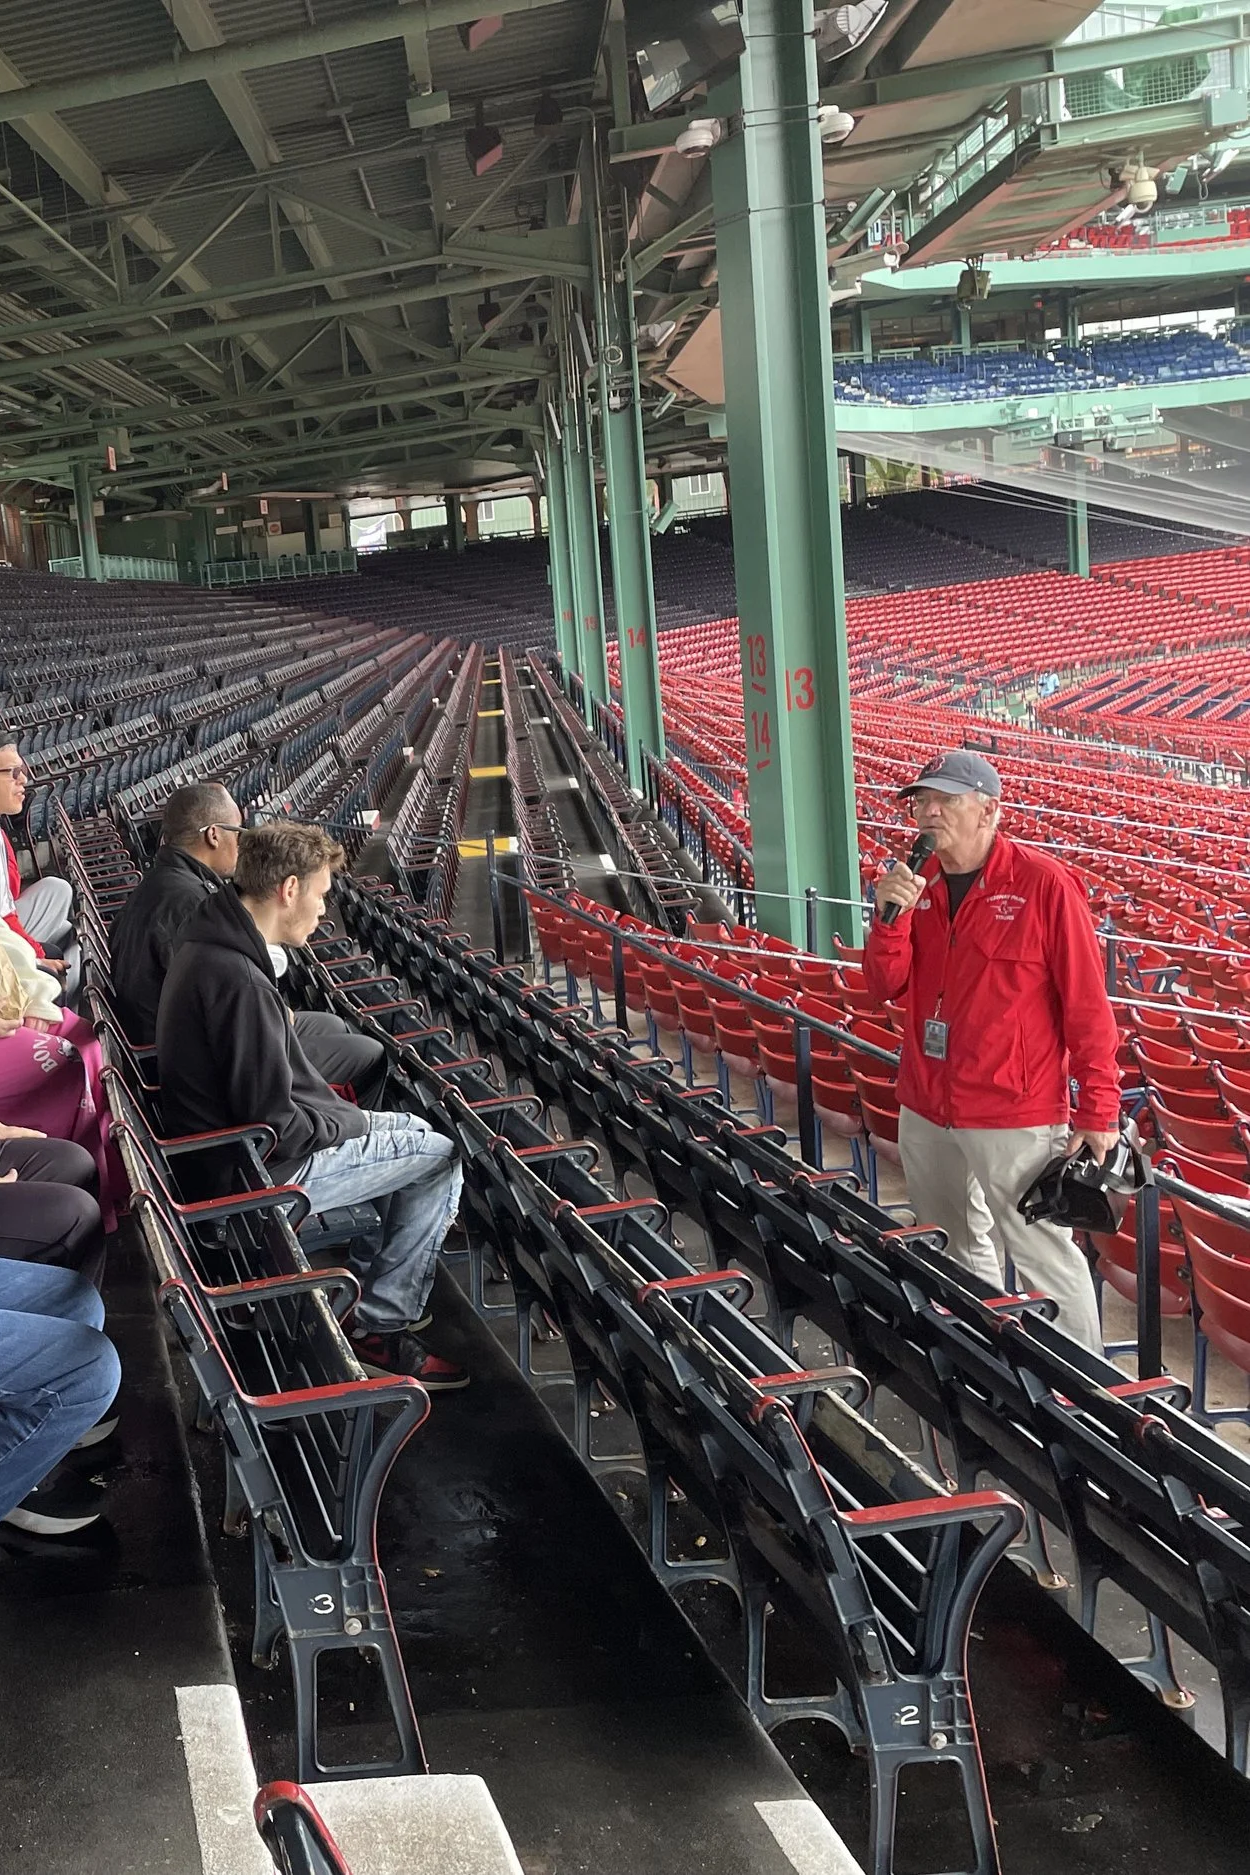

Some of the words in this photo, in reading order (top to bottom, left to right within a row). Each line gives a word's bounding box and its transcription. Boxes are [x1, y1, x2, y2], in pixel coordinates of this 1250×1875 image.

[627, 623, 647, 650] 14
[746, 634, 767, 677] 13
[785, 667, 816, 713] 13
[751, 710, 772, 754] 14
[313, 1593, 335, 1615] 3
[900, 1705, 920, 1726] 2
